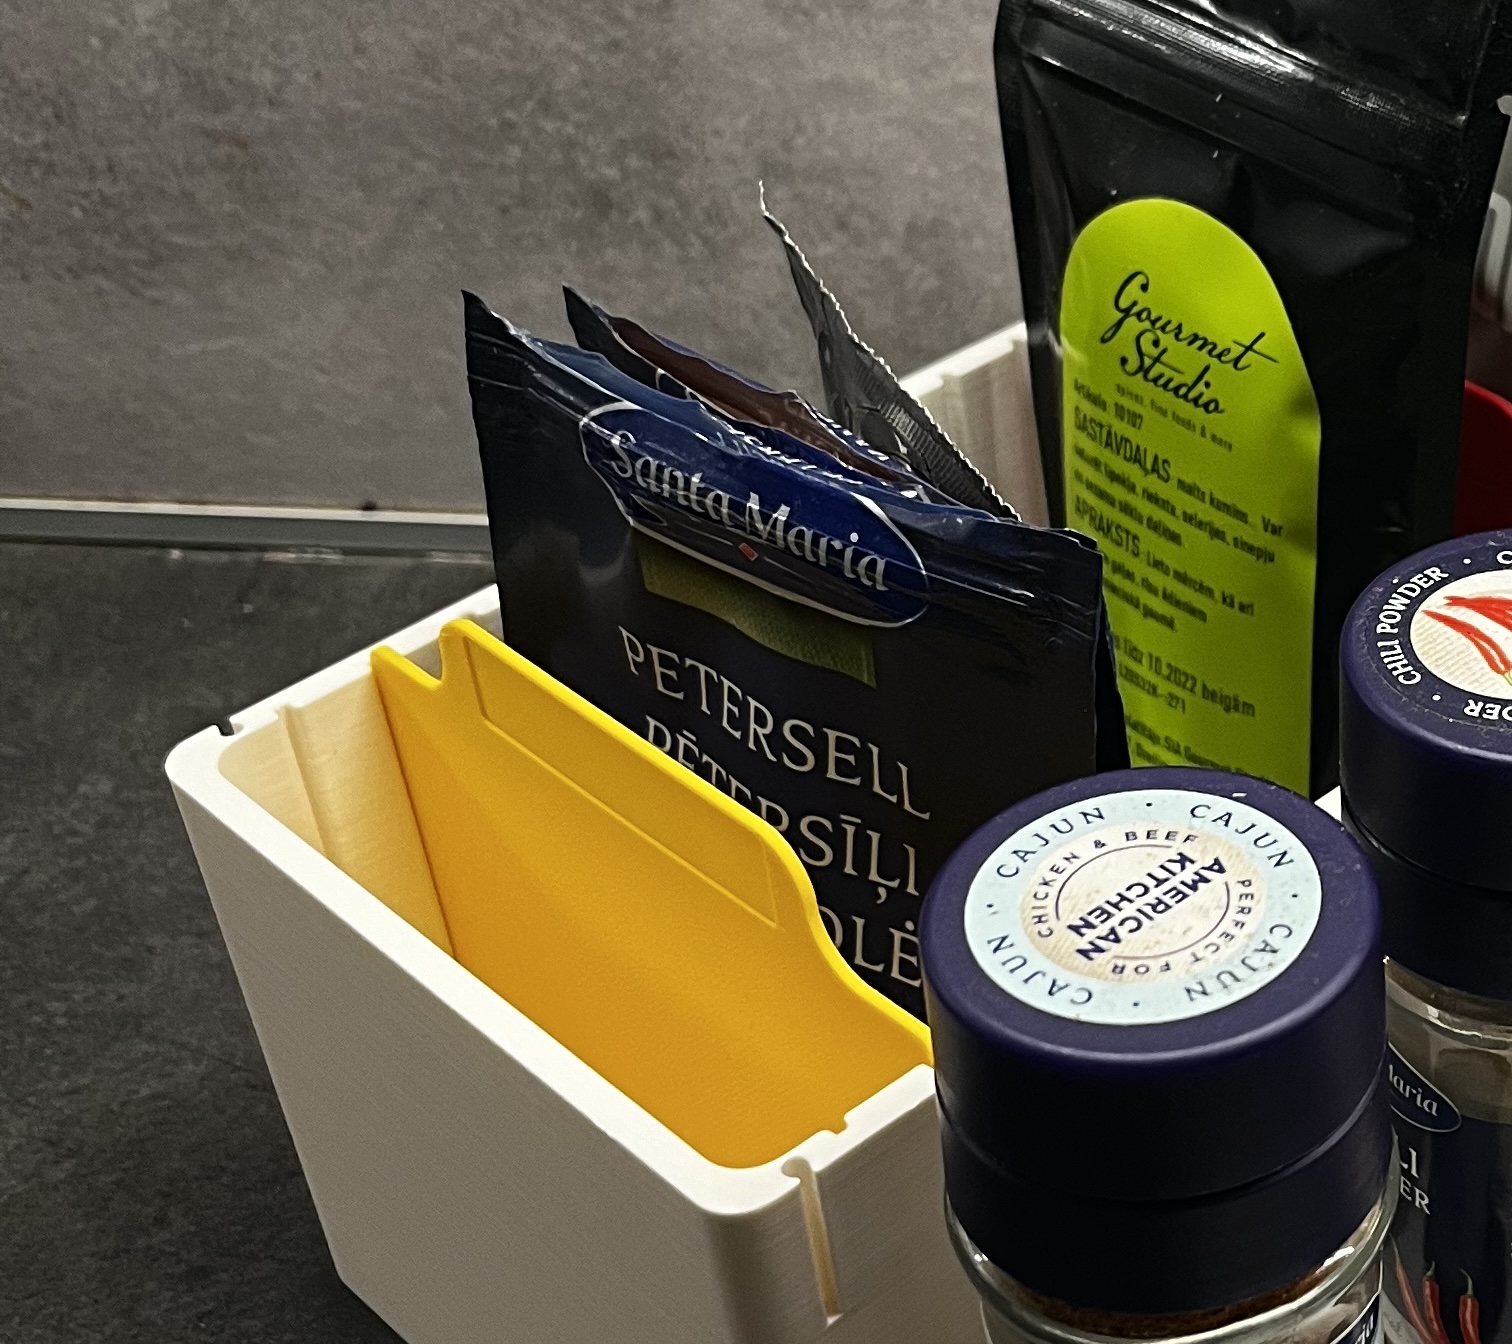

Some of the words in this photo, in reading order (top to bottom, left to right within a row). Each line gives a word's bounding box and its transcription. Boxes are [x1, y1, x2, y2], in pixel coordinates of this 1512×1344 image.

[1099, 270, 1281, 373] Gourmet
[1119, 328, 1226, 417] Studio
[604, 428, 736, 524] Santa
[742, 489, 890, 594] Maria
[1261, 515, 1284, 537] Var
[1376, 565, 1450, 635] POWDER
[1376, 639, 1422, 687] CHILI
[617, 624, 932, 821] PETERSELL
[997, 805, 1106, 879] CAJUN
[1189, 802, 1295, 870] CAJUN
[1032, 851, 1079, 939] CHICKEN
[1123, 828, 1200, 846] BEEF
[1067, 850, 1196, 938] KITCHEN
[1076, 856, 1228, 963] AMERICAN
[1190, 877, 1256, 965] PERFECT
[987, 934, 1093, 1006] CAJUN
[1111, 960, 1171, 977] FOR
[1185, 923, 1294, 1003] CAJUN
